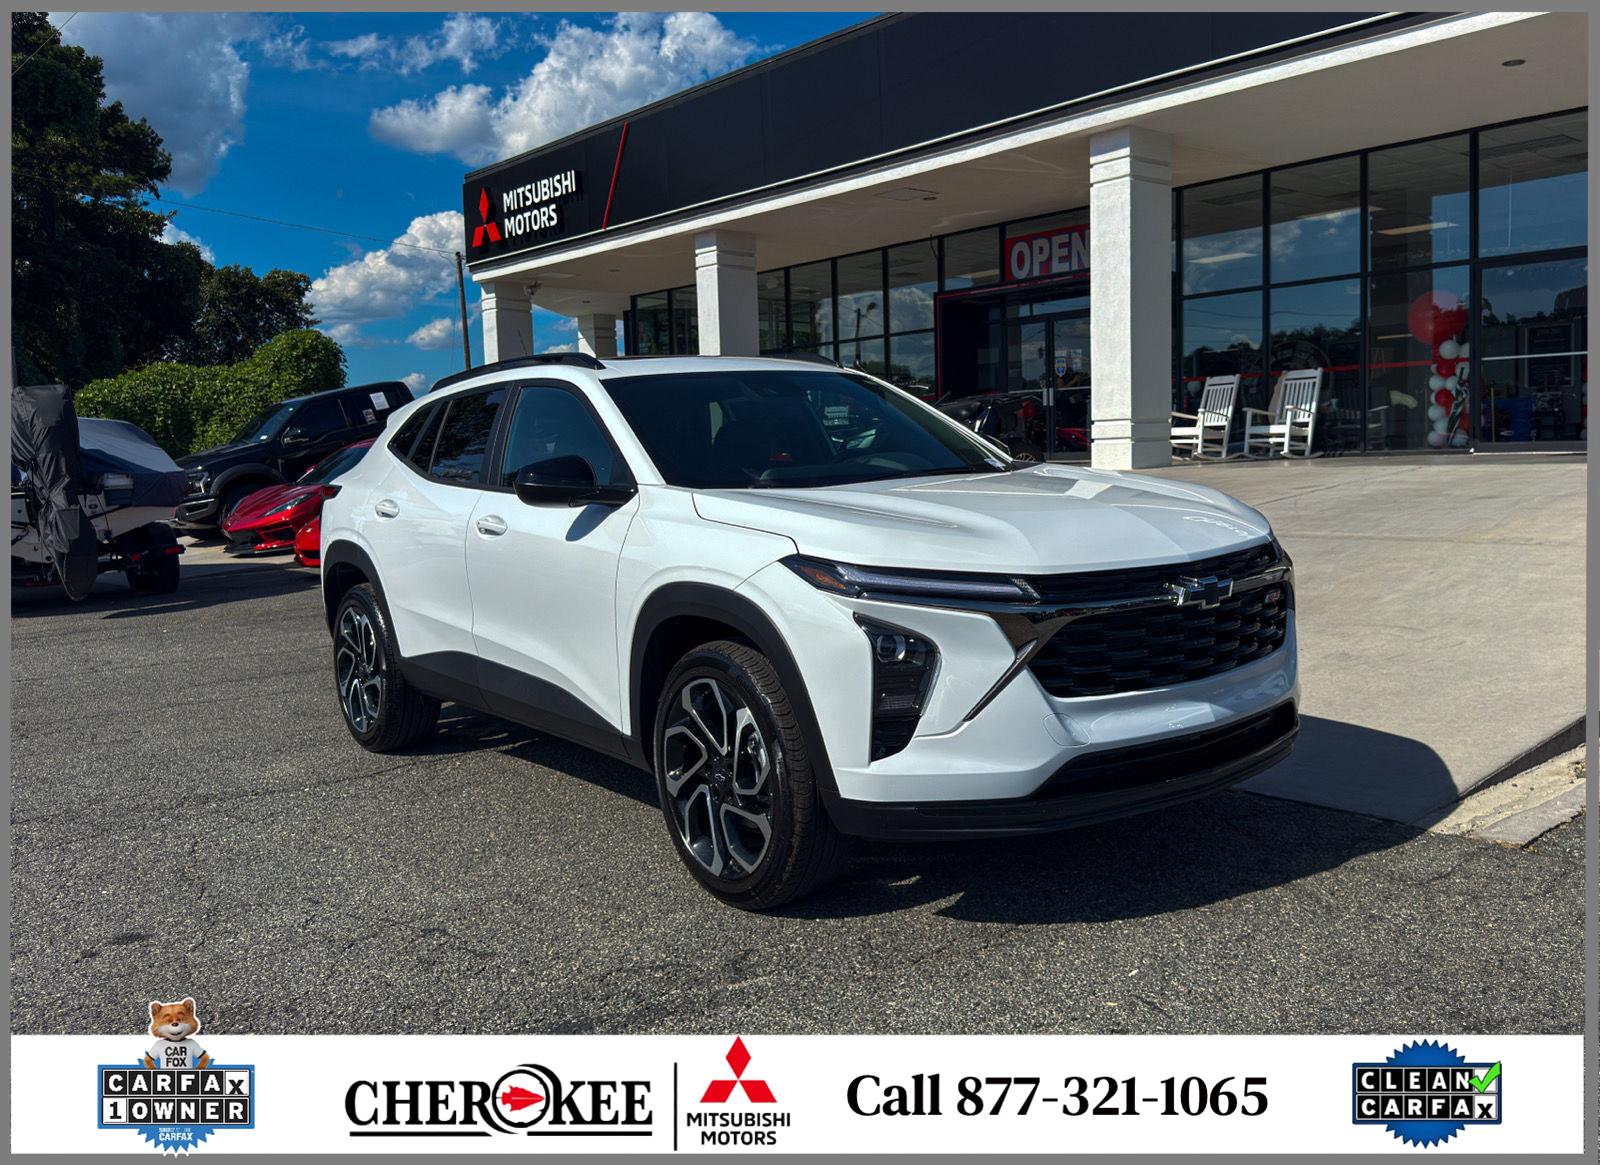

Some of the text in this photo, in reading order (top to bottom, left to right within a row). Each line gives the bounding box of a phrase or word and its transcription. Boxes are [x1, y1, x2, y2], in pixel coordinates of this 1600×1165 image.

[502, 169, 577, 213] MITSUBISHI
[504, 203, 558, 239] MOTORS
[1010, 231, 1090, 280] OPEN
